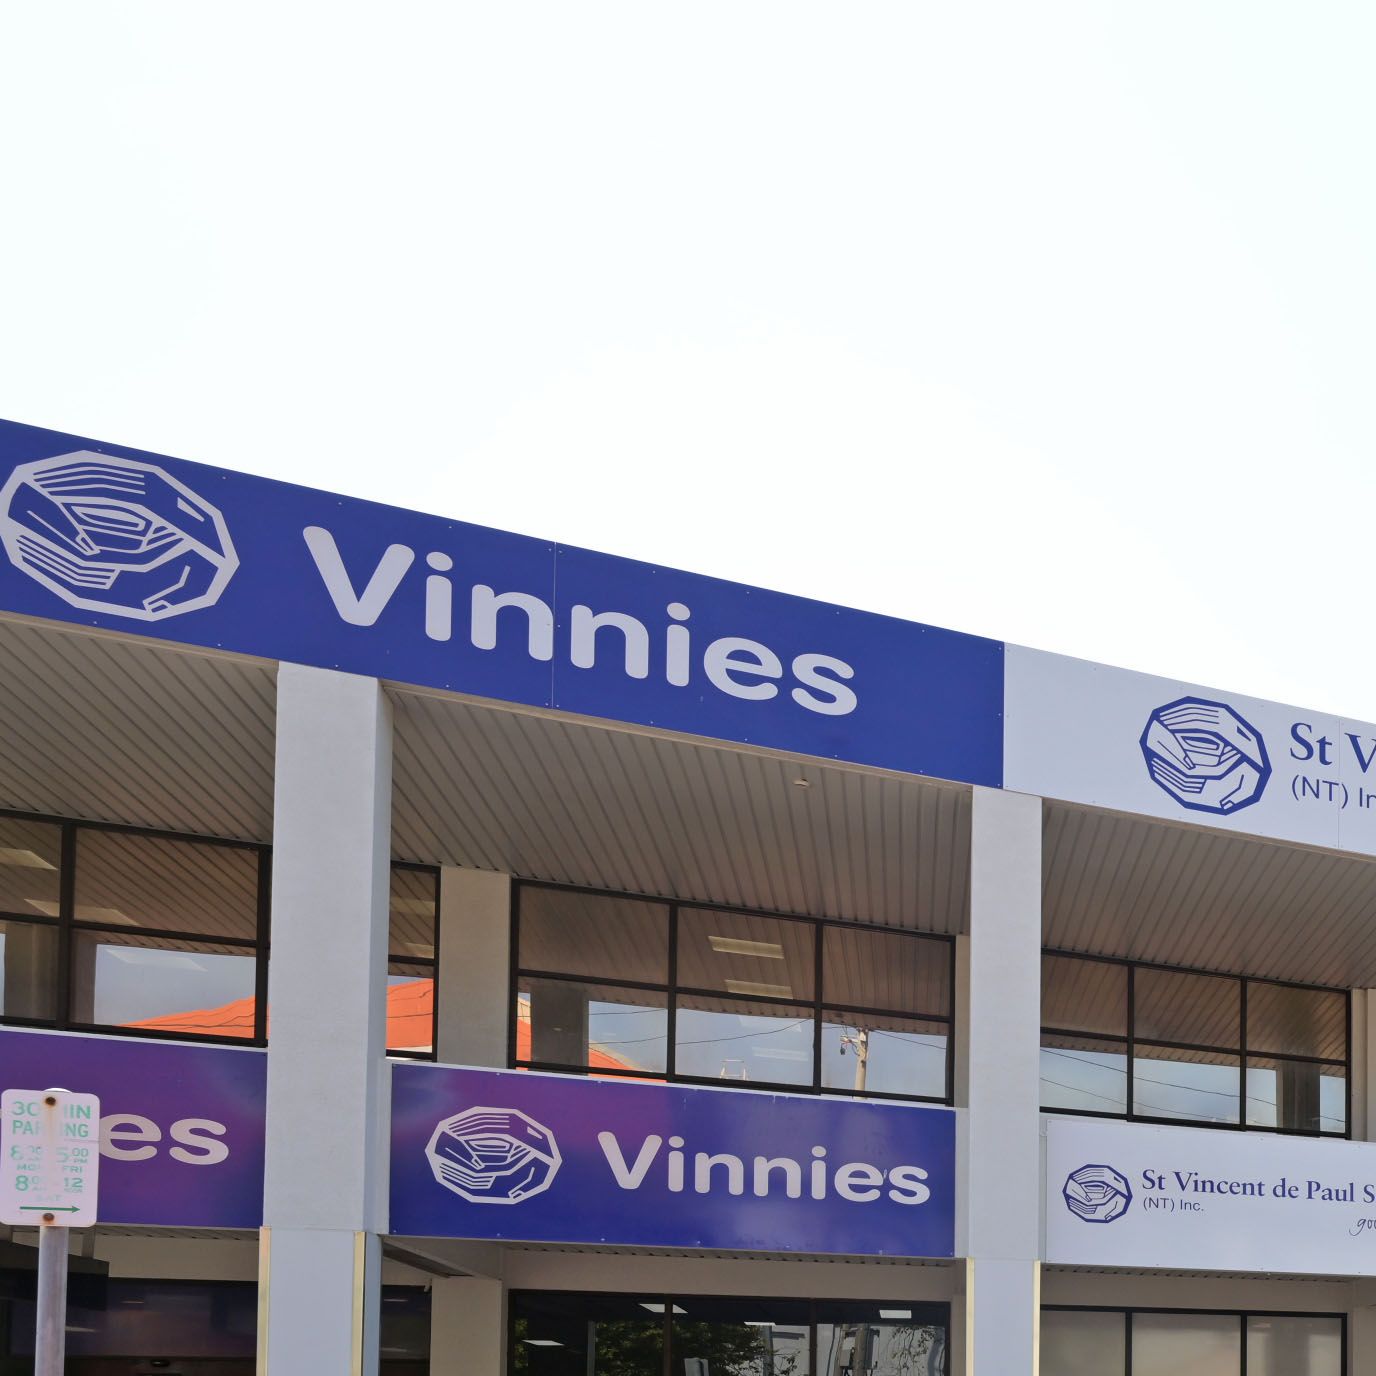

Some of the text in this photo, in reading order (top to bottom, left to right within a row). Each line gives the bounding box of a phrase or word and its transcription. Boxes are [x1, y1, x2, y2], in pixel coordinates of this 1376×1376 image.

[302, 525, 858, 717] Vinnies
[1290, 722, 1333, 766] St
[1291, 774, 1349, 810] (NT)
[62, 1103, 91, 1119] IN
[597, 1131, 931, 1206] Vinnies
[1142, 1168, 1167, 1191] St
[1172, 1171, 1267, 1197] Vincent
[1272, 1177, 1299, 1199] de
[1305, 1180, 1355, 1203] Paul
[1143, 1197, 1205, 1213] (NT) Inc.
